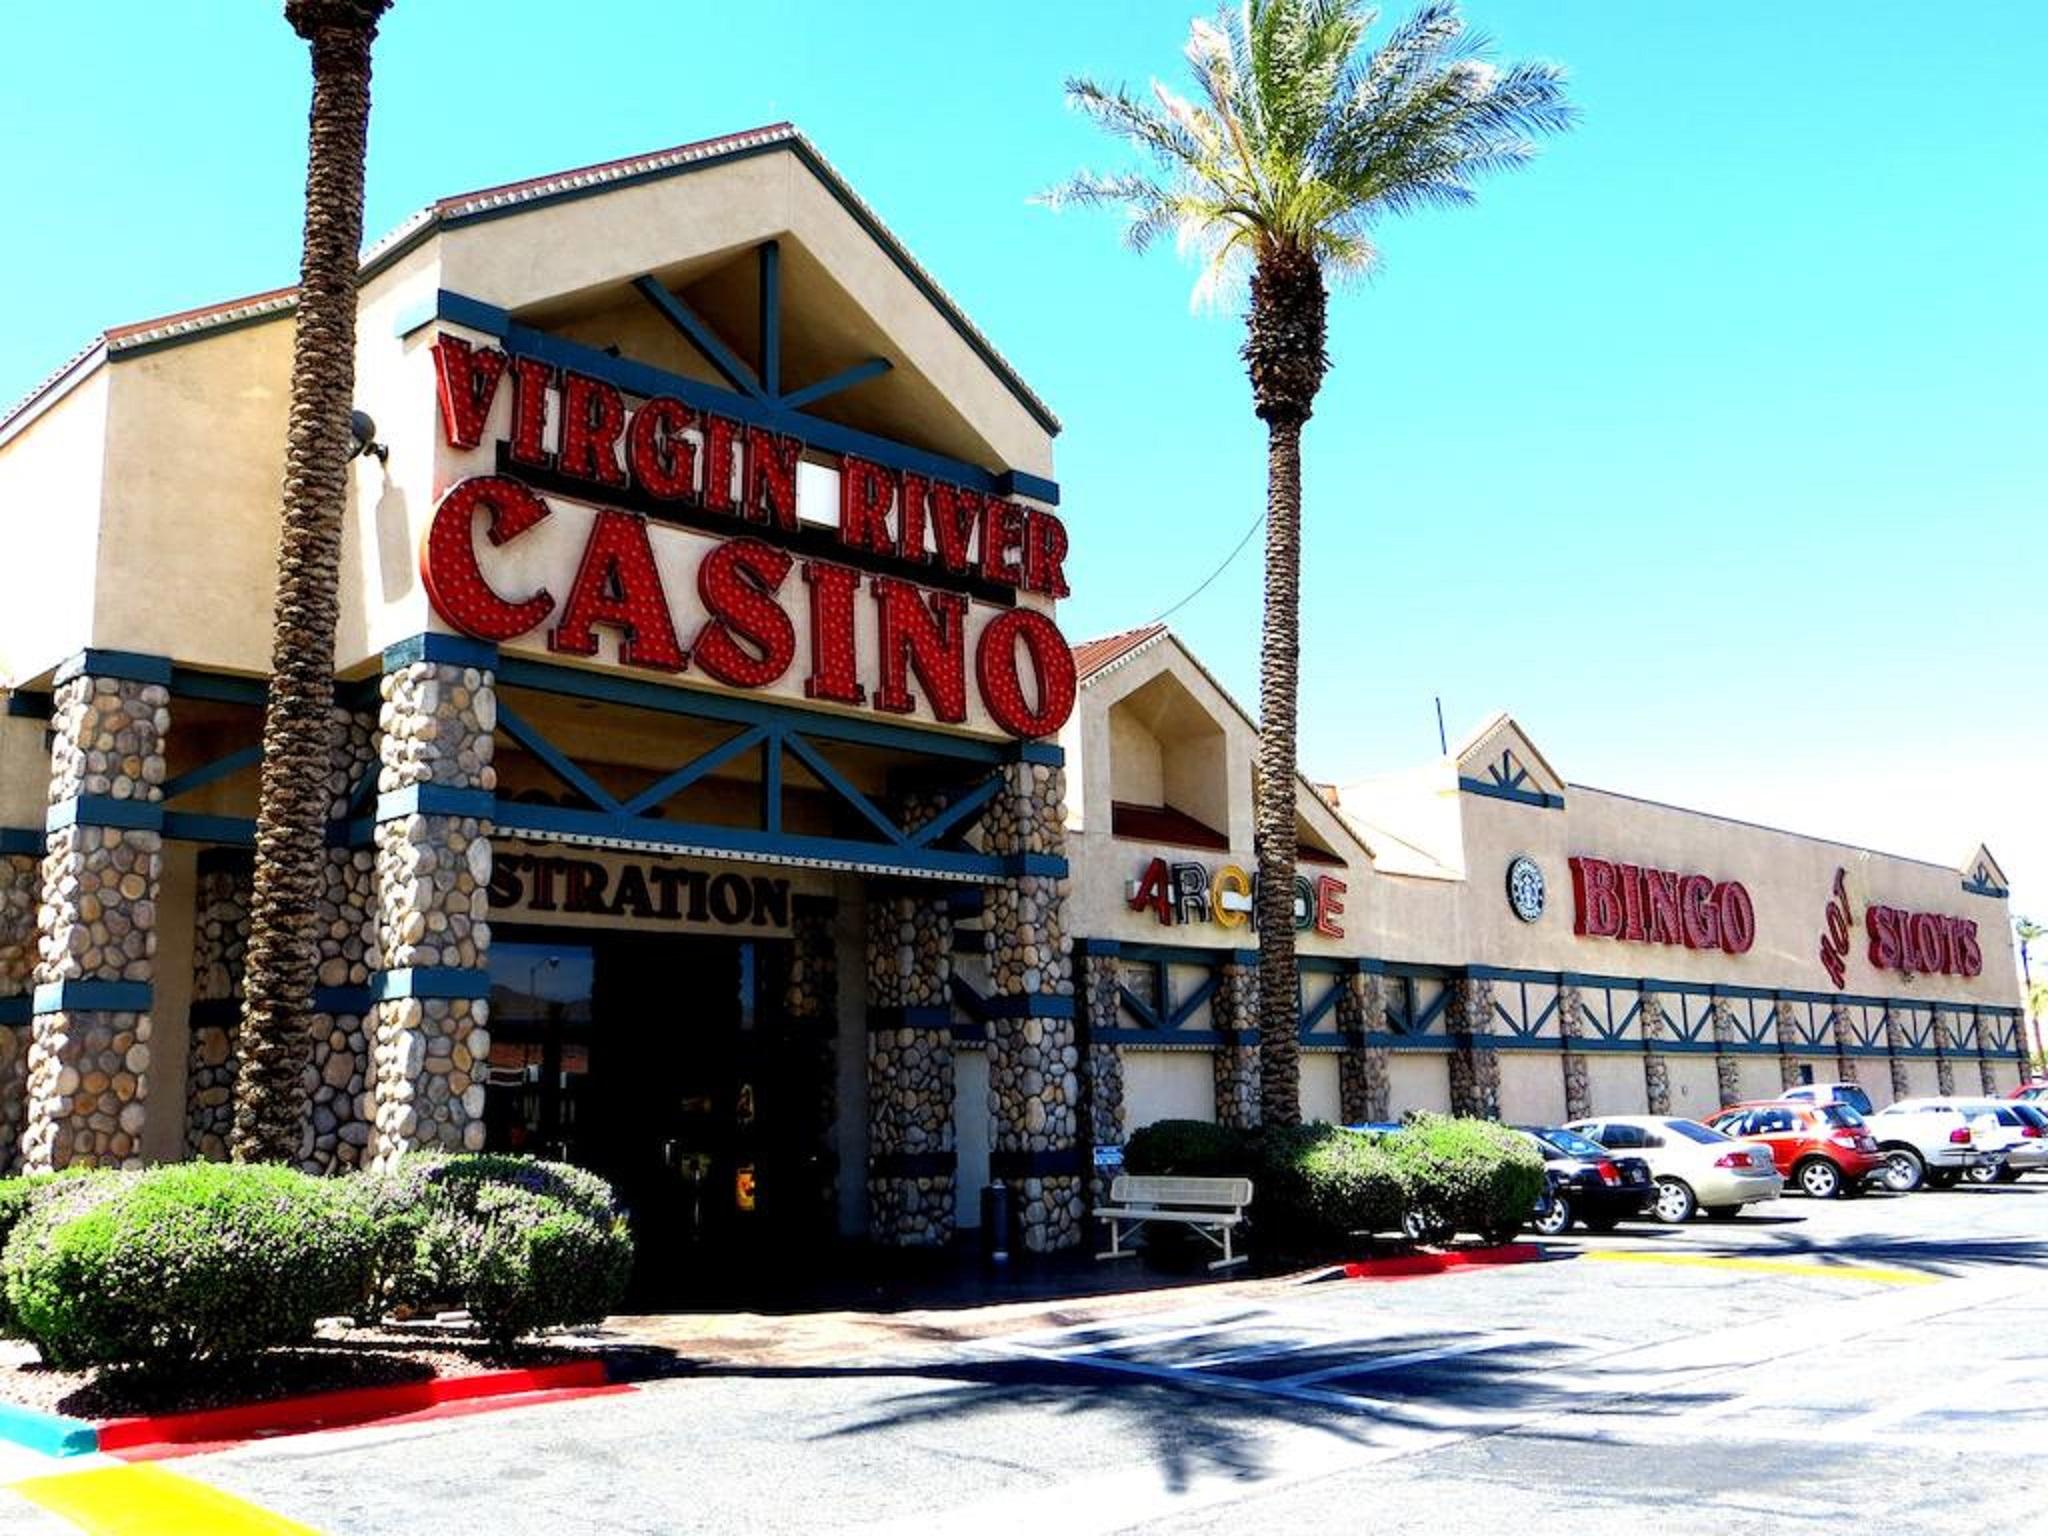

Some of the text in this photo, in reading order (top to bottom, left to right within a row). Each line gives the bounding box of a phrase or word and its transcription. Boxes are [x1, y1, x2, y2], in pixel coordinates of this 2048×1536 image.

[430, 331, 1070, 599] VIRGIN RIVER
[420, 474, 1077, 740] CASINO
[1127, 856, 1347, 939] ARCDE
[1568, 856, 1756, 955] BINGO
[1865, 905, 1983, 977] SLOTS
